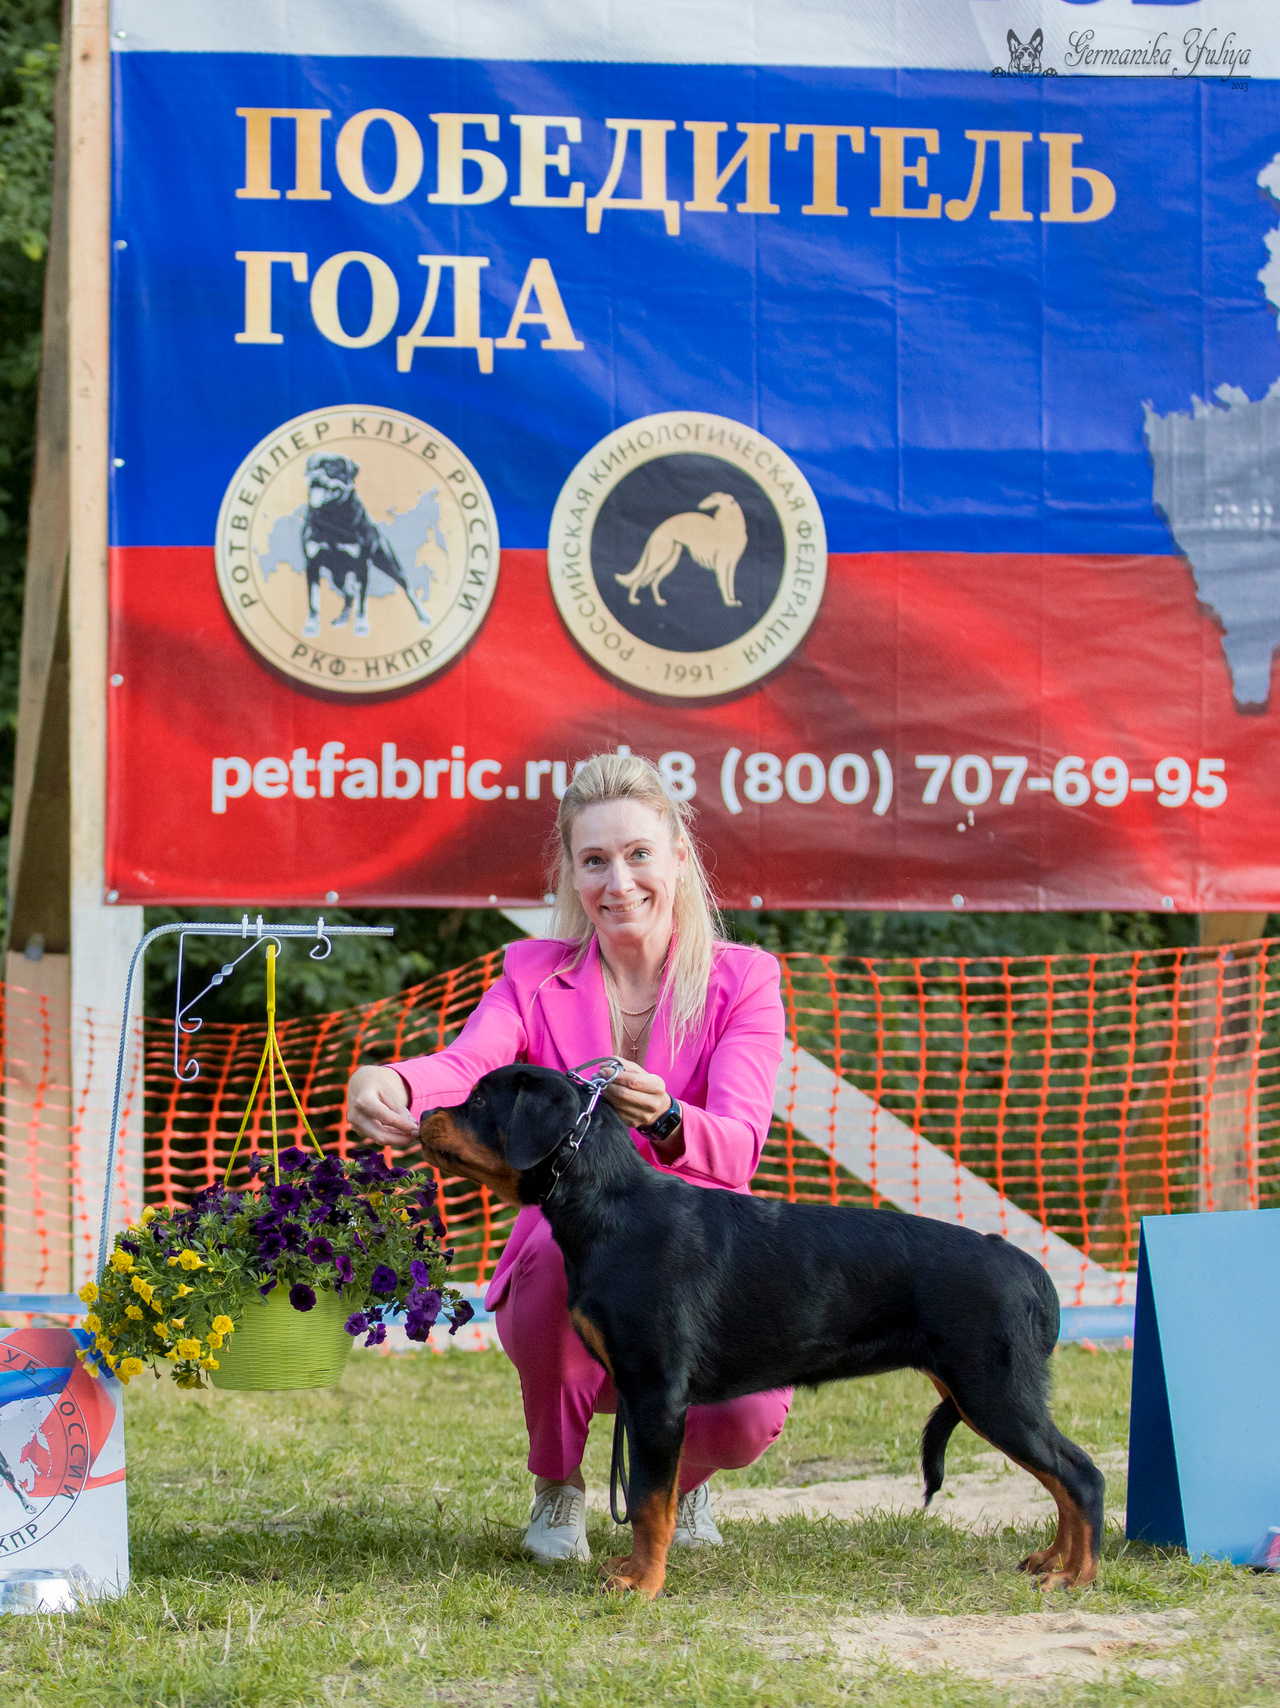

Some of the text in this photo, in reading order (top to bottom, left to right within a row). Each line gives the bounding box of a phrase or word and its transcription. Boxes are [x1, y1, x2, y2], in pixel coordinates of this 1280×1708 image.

[235, 107, 1116, 236] ПОБЕДИТЕЛЬ
[235, 250, 584, 374] ГОДА
[351, 417, 440, 461] КЛУБ
[447, 469, 489, 613] РОССИИ
[561, 422, 816, 665] РОССИЙСКАЯ КИНОЛОГИЧЕСКАЯ ФЕДЕРАЦИЯ
[291, 638, 433, 678] РКФ-НКПР
[664, 663, 715, 683] 1991
[720, 747, 894, 816] (800)
[914, 754, 1228, 807] 707-69-95
[46, 1381, 86, 1501] РОССИИ
